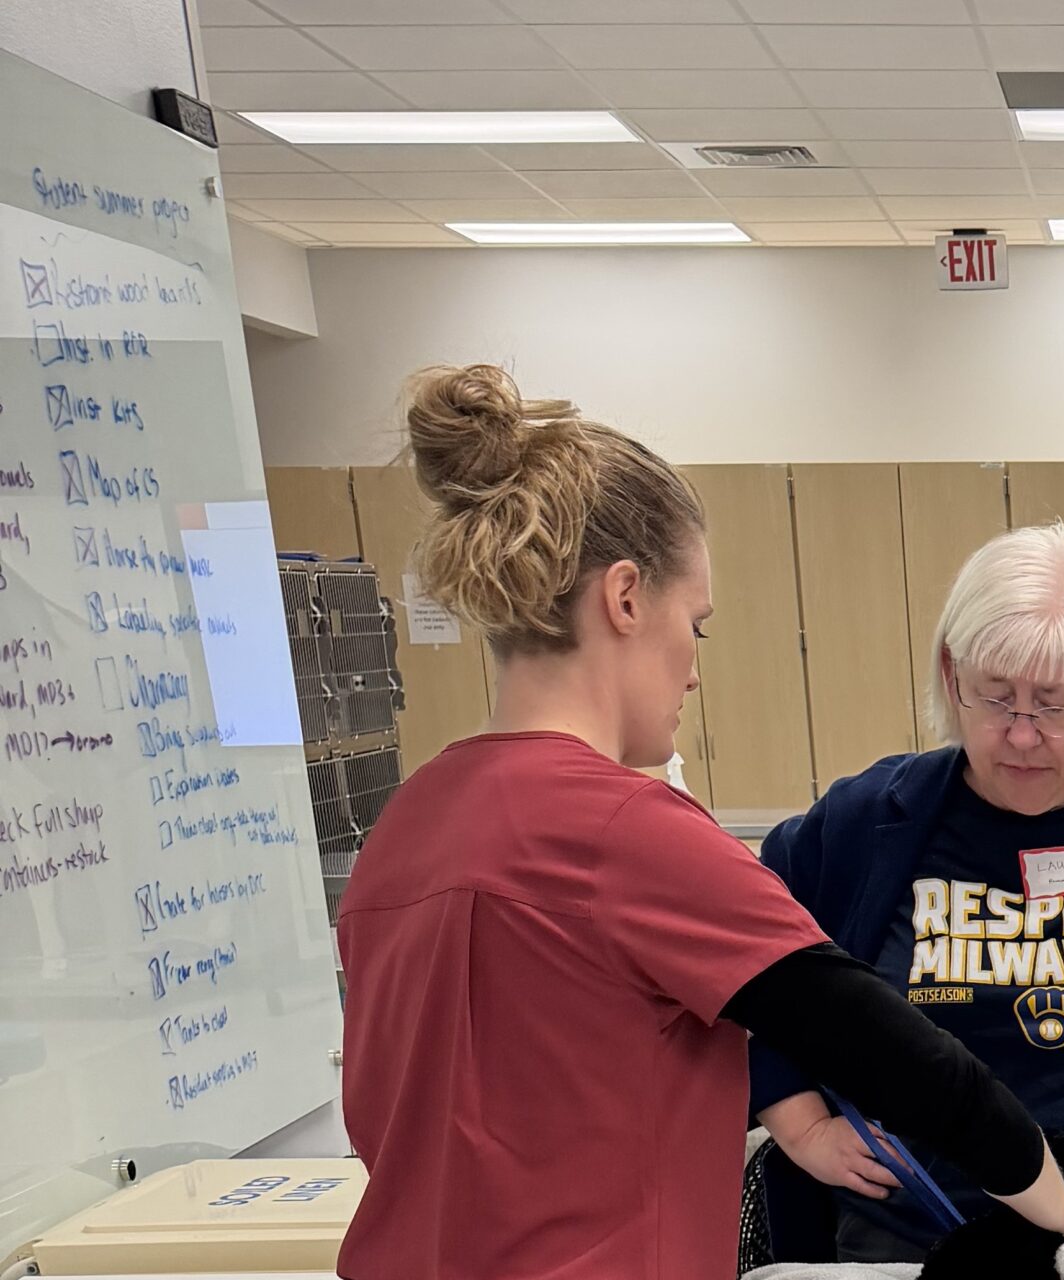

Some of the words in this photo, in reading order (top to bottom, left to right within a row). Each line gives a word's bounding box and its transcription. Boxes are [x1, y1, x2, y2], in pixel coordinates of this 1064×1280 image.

[947, 239, 998, 283] EXIT
[908, 987, 967, 1004] POSTSEASON
[207, 1175, 291, 1206] SOILED
[271, 1177, 351, 1202] LINEN
